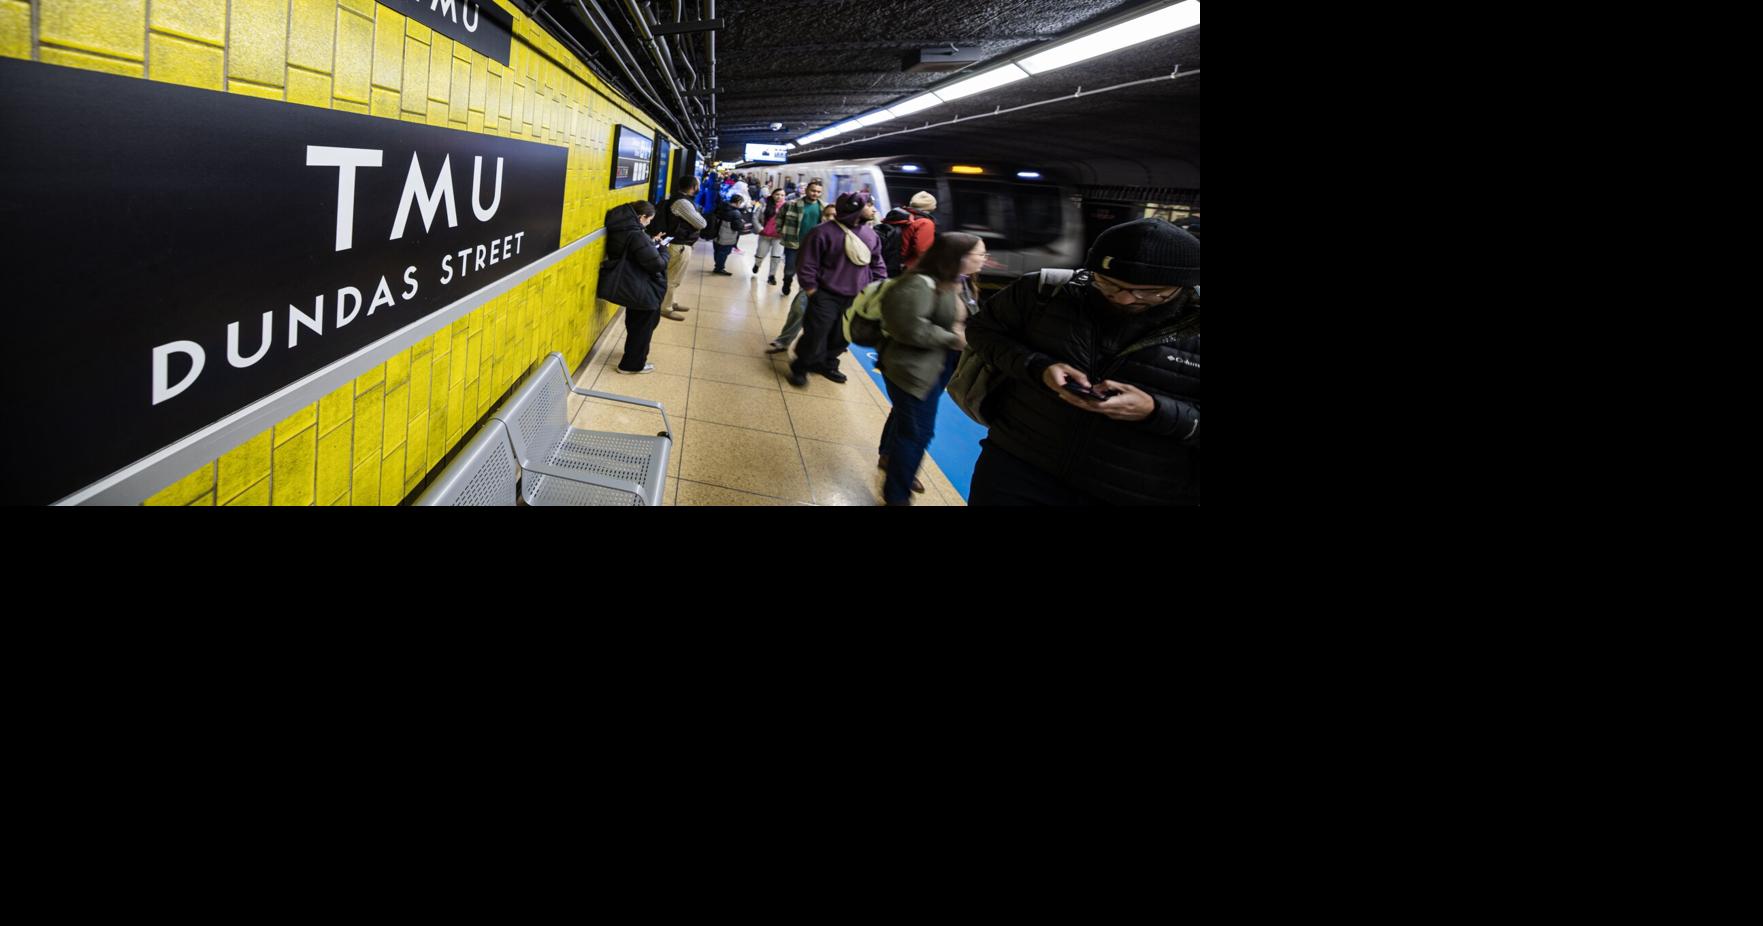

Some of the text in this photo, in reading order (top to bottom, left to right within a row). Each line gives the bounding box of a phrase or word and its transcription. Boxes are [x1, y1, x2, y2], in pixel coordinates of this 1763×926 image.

[416, 0, 480, 33] MU
[305, 144, 504, 252] TMU
[152, 231, 525, 405] DUNDAS STREET
